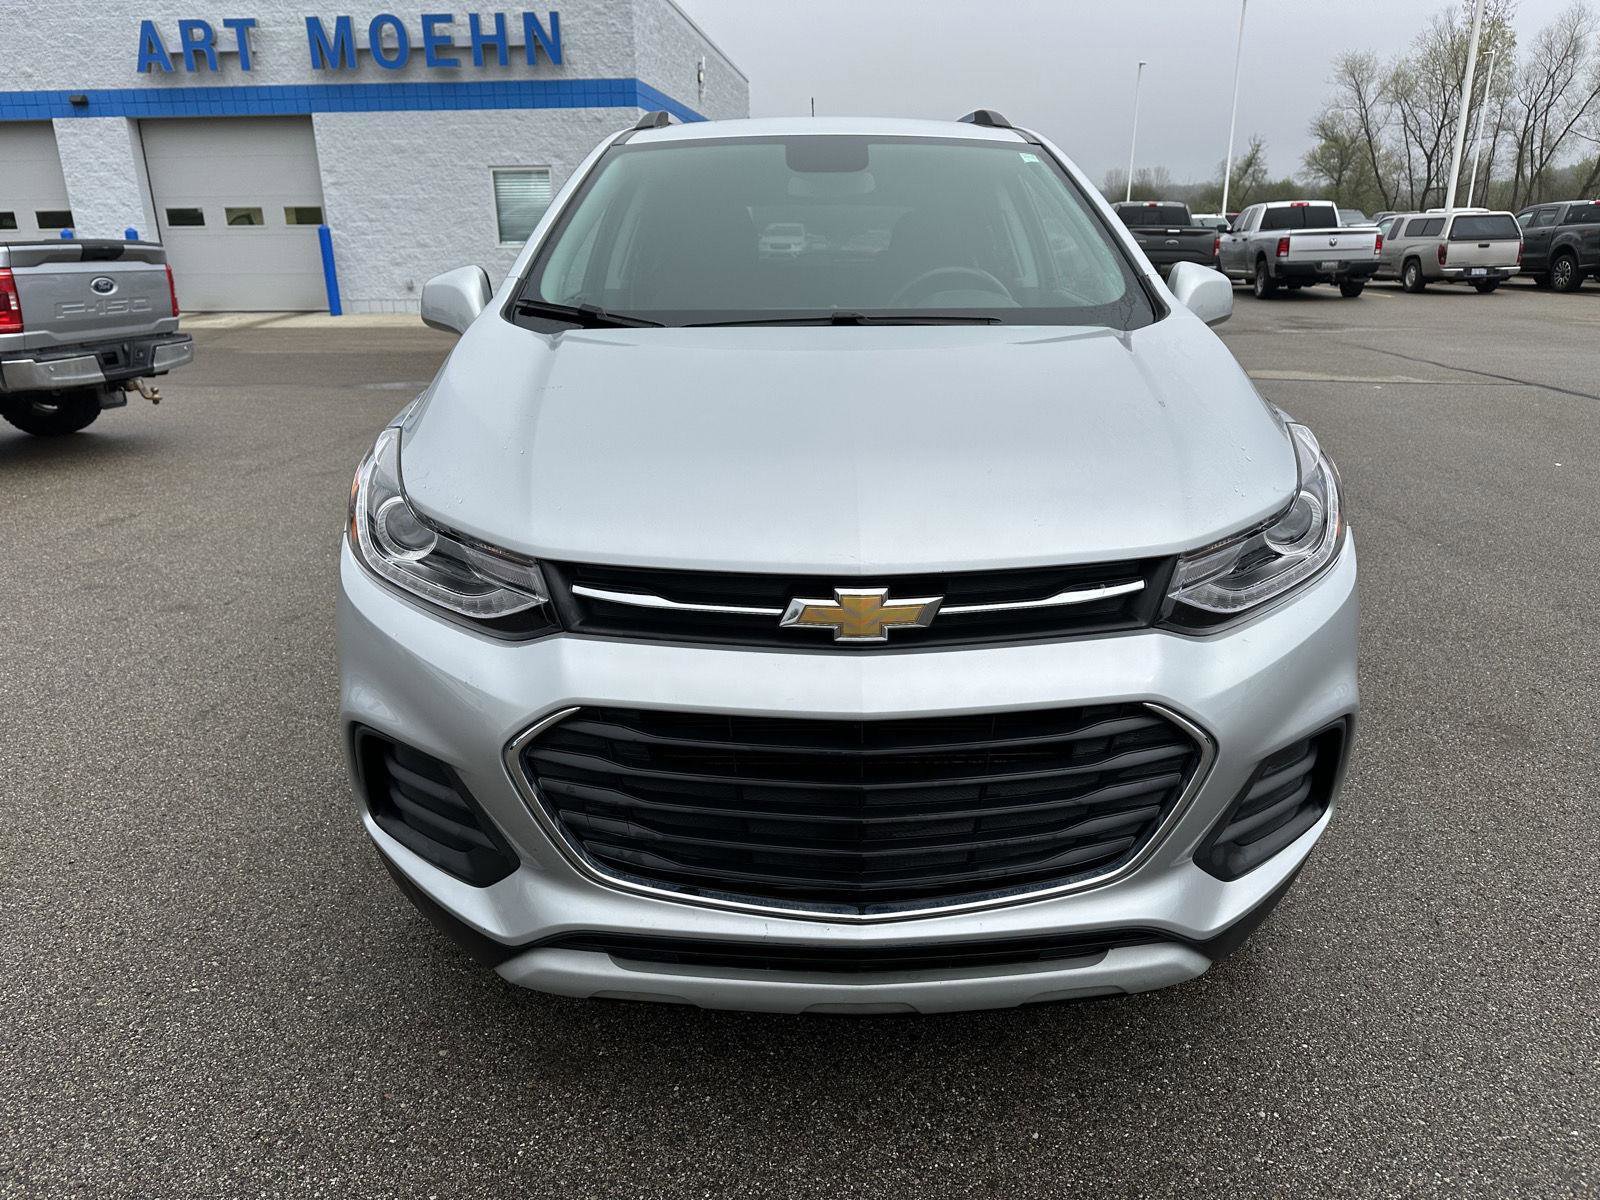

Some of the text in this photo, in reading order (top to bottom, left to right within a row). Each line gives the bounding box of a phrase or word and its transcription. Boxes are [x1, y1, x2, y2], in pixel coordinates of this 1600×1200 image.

[137, 11, 562, 73] ART MOEHN
[55, 297, 152, 319] F-150
